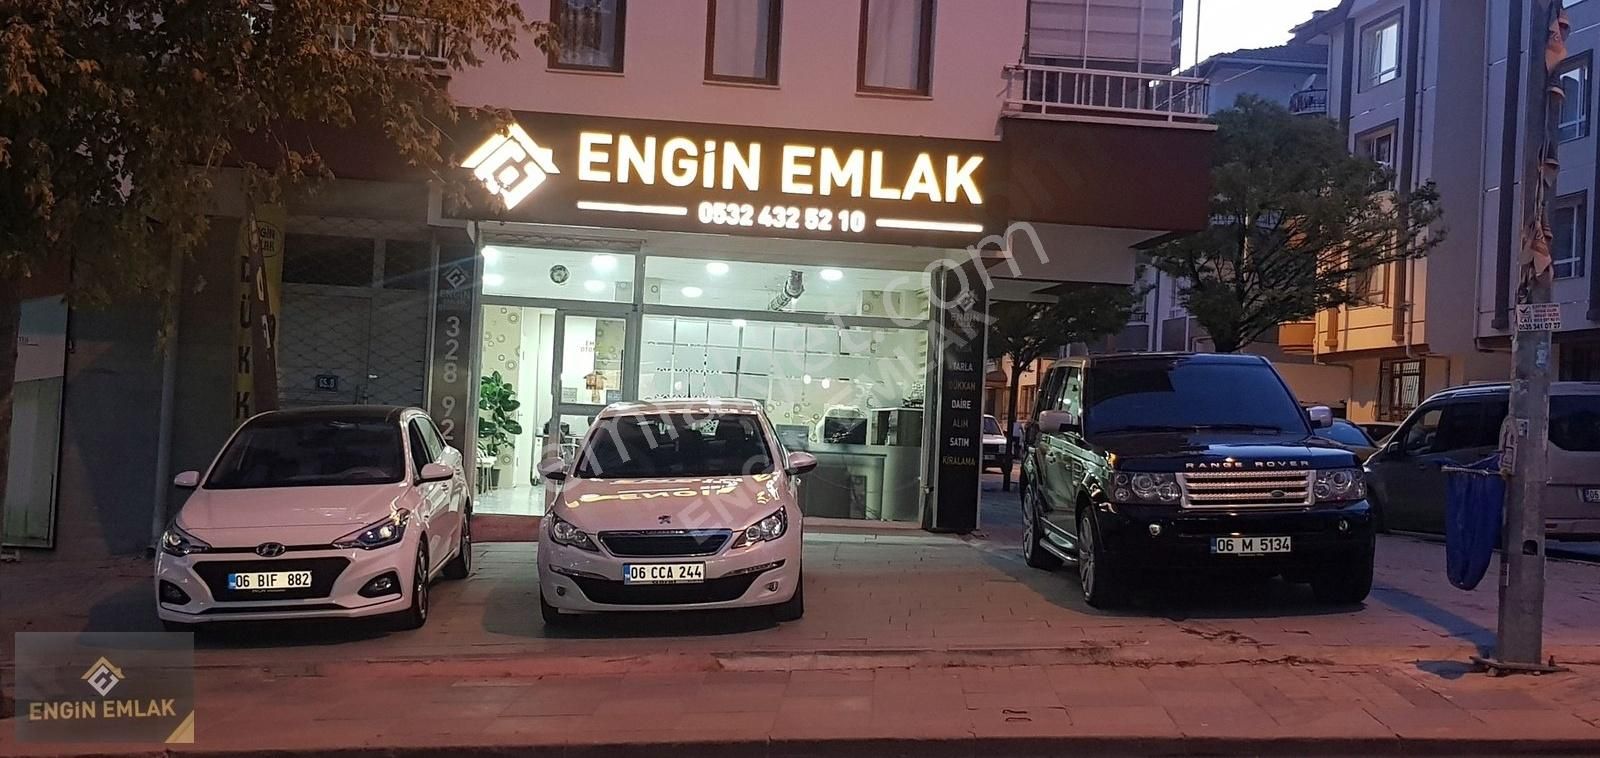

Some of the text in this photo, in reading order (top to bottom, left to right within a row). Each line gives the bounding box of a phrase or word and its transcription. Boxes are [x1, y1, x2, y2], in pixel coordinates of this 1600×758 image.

[781, 145, 984, 205] EMLAK
[698, 201, 866, 233] 0532 432 52 10
[443, 315, 461, 384] 328
[949, 437, 970, 447] SATIM
[942, 455, 976, 466] KIRALAMA
[1217, 538, 1290, 552] 06 M 5134
[235, 572, 310, 588] 06 BIF 882
[631, 565, 702, 580] 06 CCA 244
